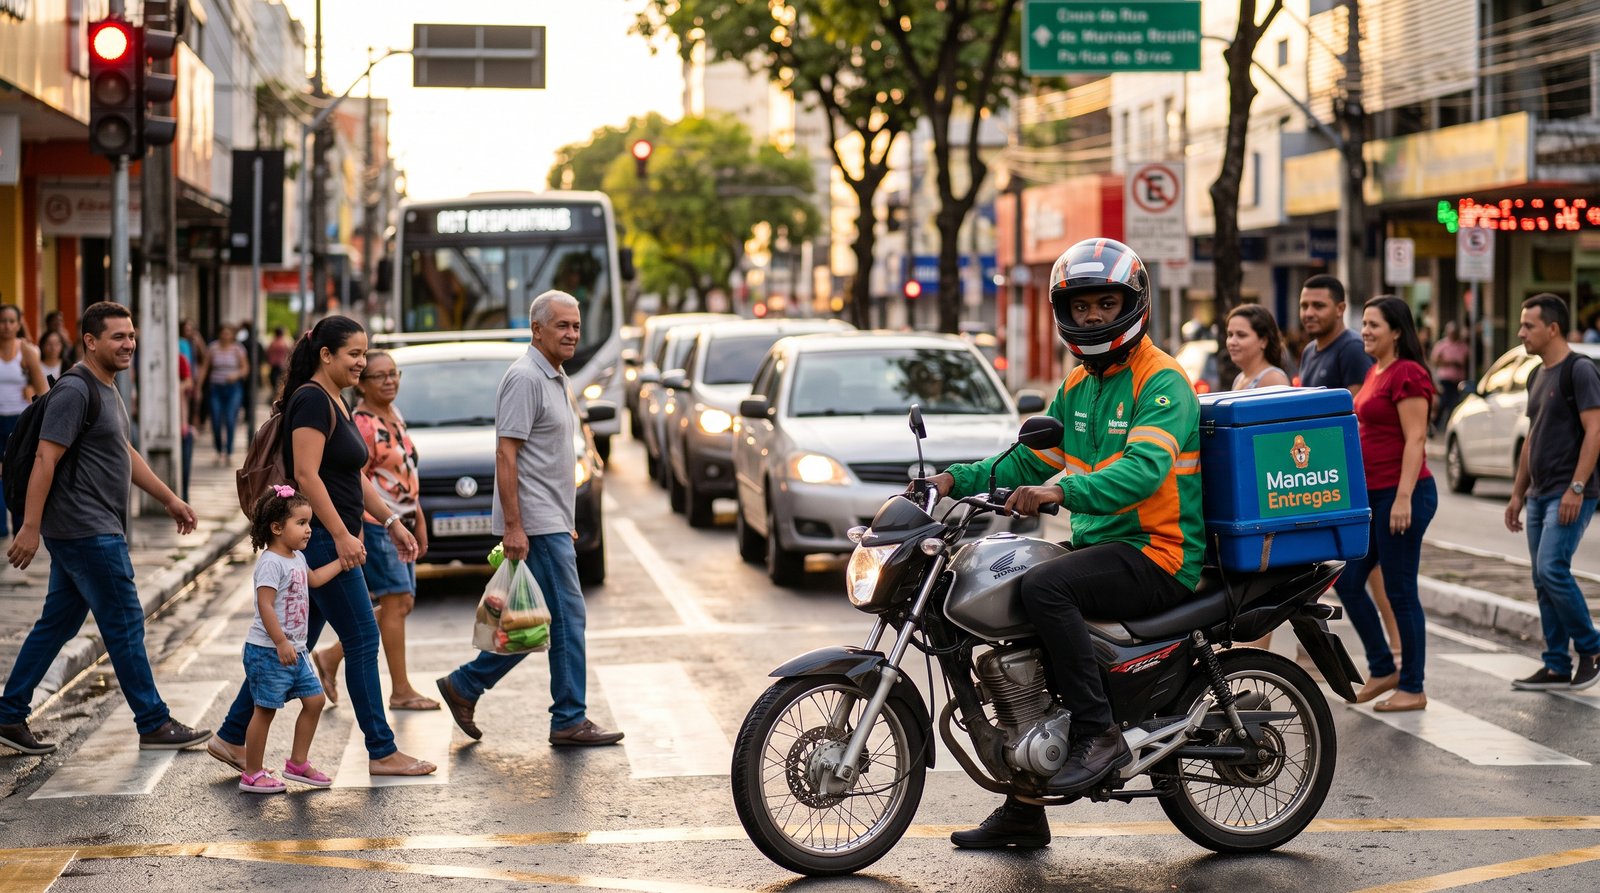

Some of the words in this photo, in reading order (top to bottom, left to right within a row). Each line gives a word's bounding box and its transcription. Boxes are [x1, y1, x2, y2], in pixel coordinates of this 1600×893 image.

[1266, 469, 1339, 490] Manaus
[1268, 489, 1341, 509] Entregas
[993, 565, 1027, 580] HONDA
